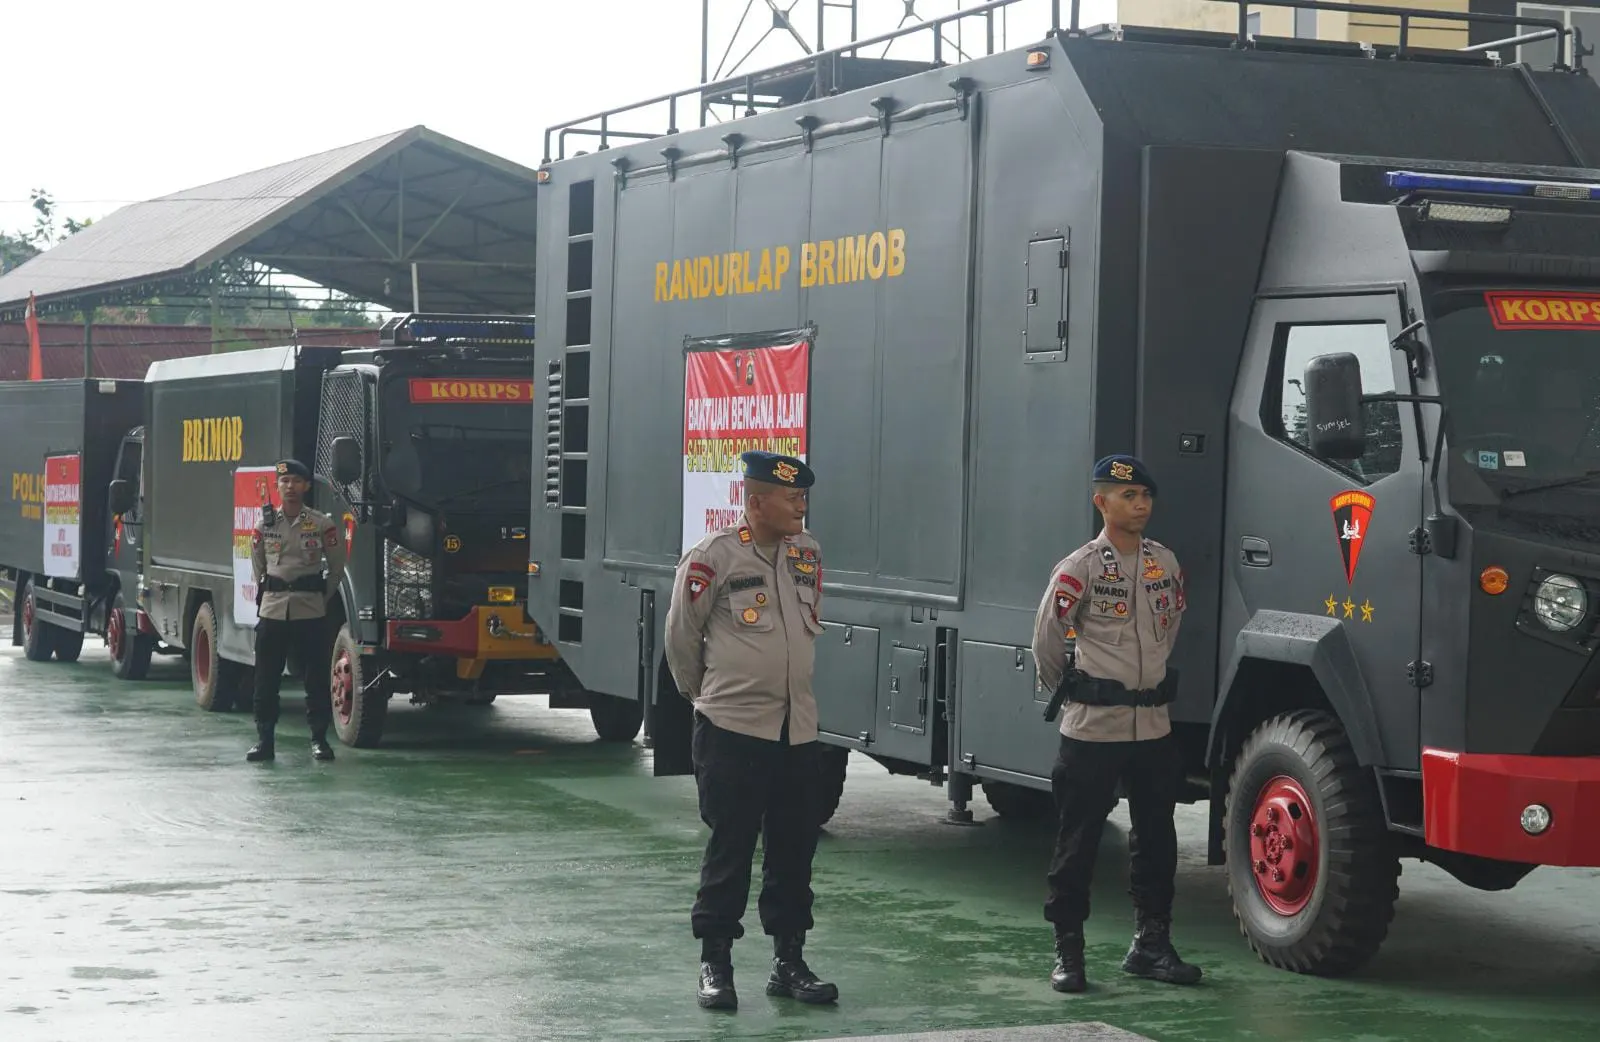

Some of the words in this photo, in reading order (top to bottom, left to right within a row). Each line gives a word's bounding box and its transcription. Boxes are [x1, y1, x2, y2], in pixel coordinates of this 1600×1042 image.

[655, 246, 790, 302] RANDURLAP
[800, 228, 906, 288] BRIMOB
[1502, 299, 1600, 321] KORPS
[430, 382, 520, 399] KORPS
[731, 394, 774, 430] BENCANA
[776, 392, 804, 428] ALAM
[182, 416, 243, 462] BRIMOB
[687, 438, 734, 473] SATBRIMOB
[12, 472, 46, 503] POLIS
[729, 480, 745, 506] UNT
[1094, 584, 1128, 598] WARDI
